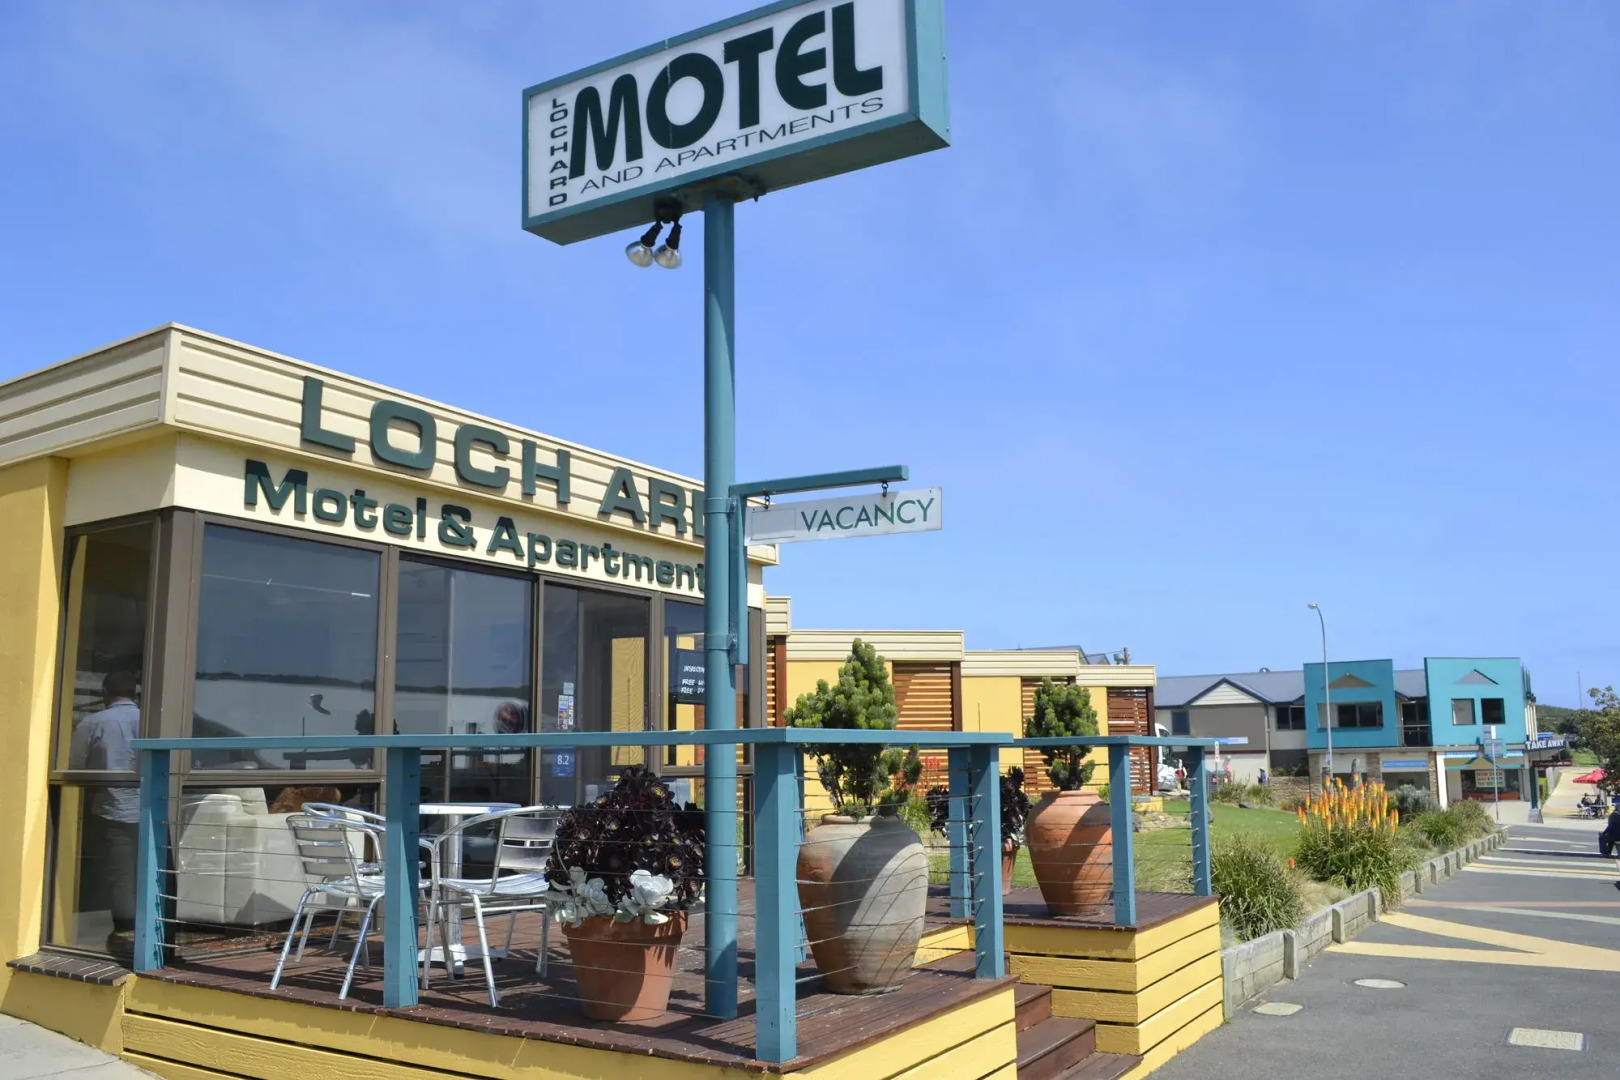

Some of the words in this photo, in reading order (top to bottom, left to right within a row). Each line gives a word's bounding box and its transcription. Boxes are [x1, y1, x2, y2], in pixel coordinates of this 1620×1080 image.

[569, 1, 883, 180] MOTEL
[581, 166, 643, 194] AND
[654, 97, 883, 172] APARTMENTS
[301, 376, 571, 504] LOCH
[244, 459, 426, 538] Motel
[438, 504, 477, 549] &
[487, 517, 705, 592] Apartment
[801, 498, 934, 532] VACANCY
[557, 755, 569, 765] 8.2
[1525, 740, 1547, 750] TAKE
[1548, 739, 1564, 748] AWAY
